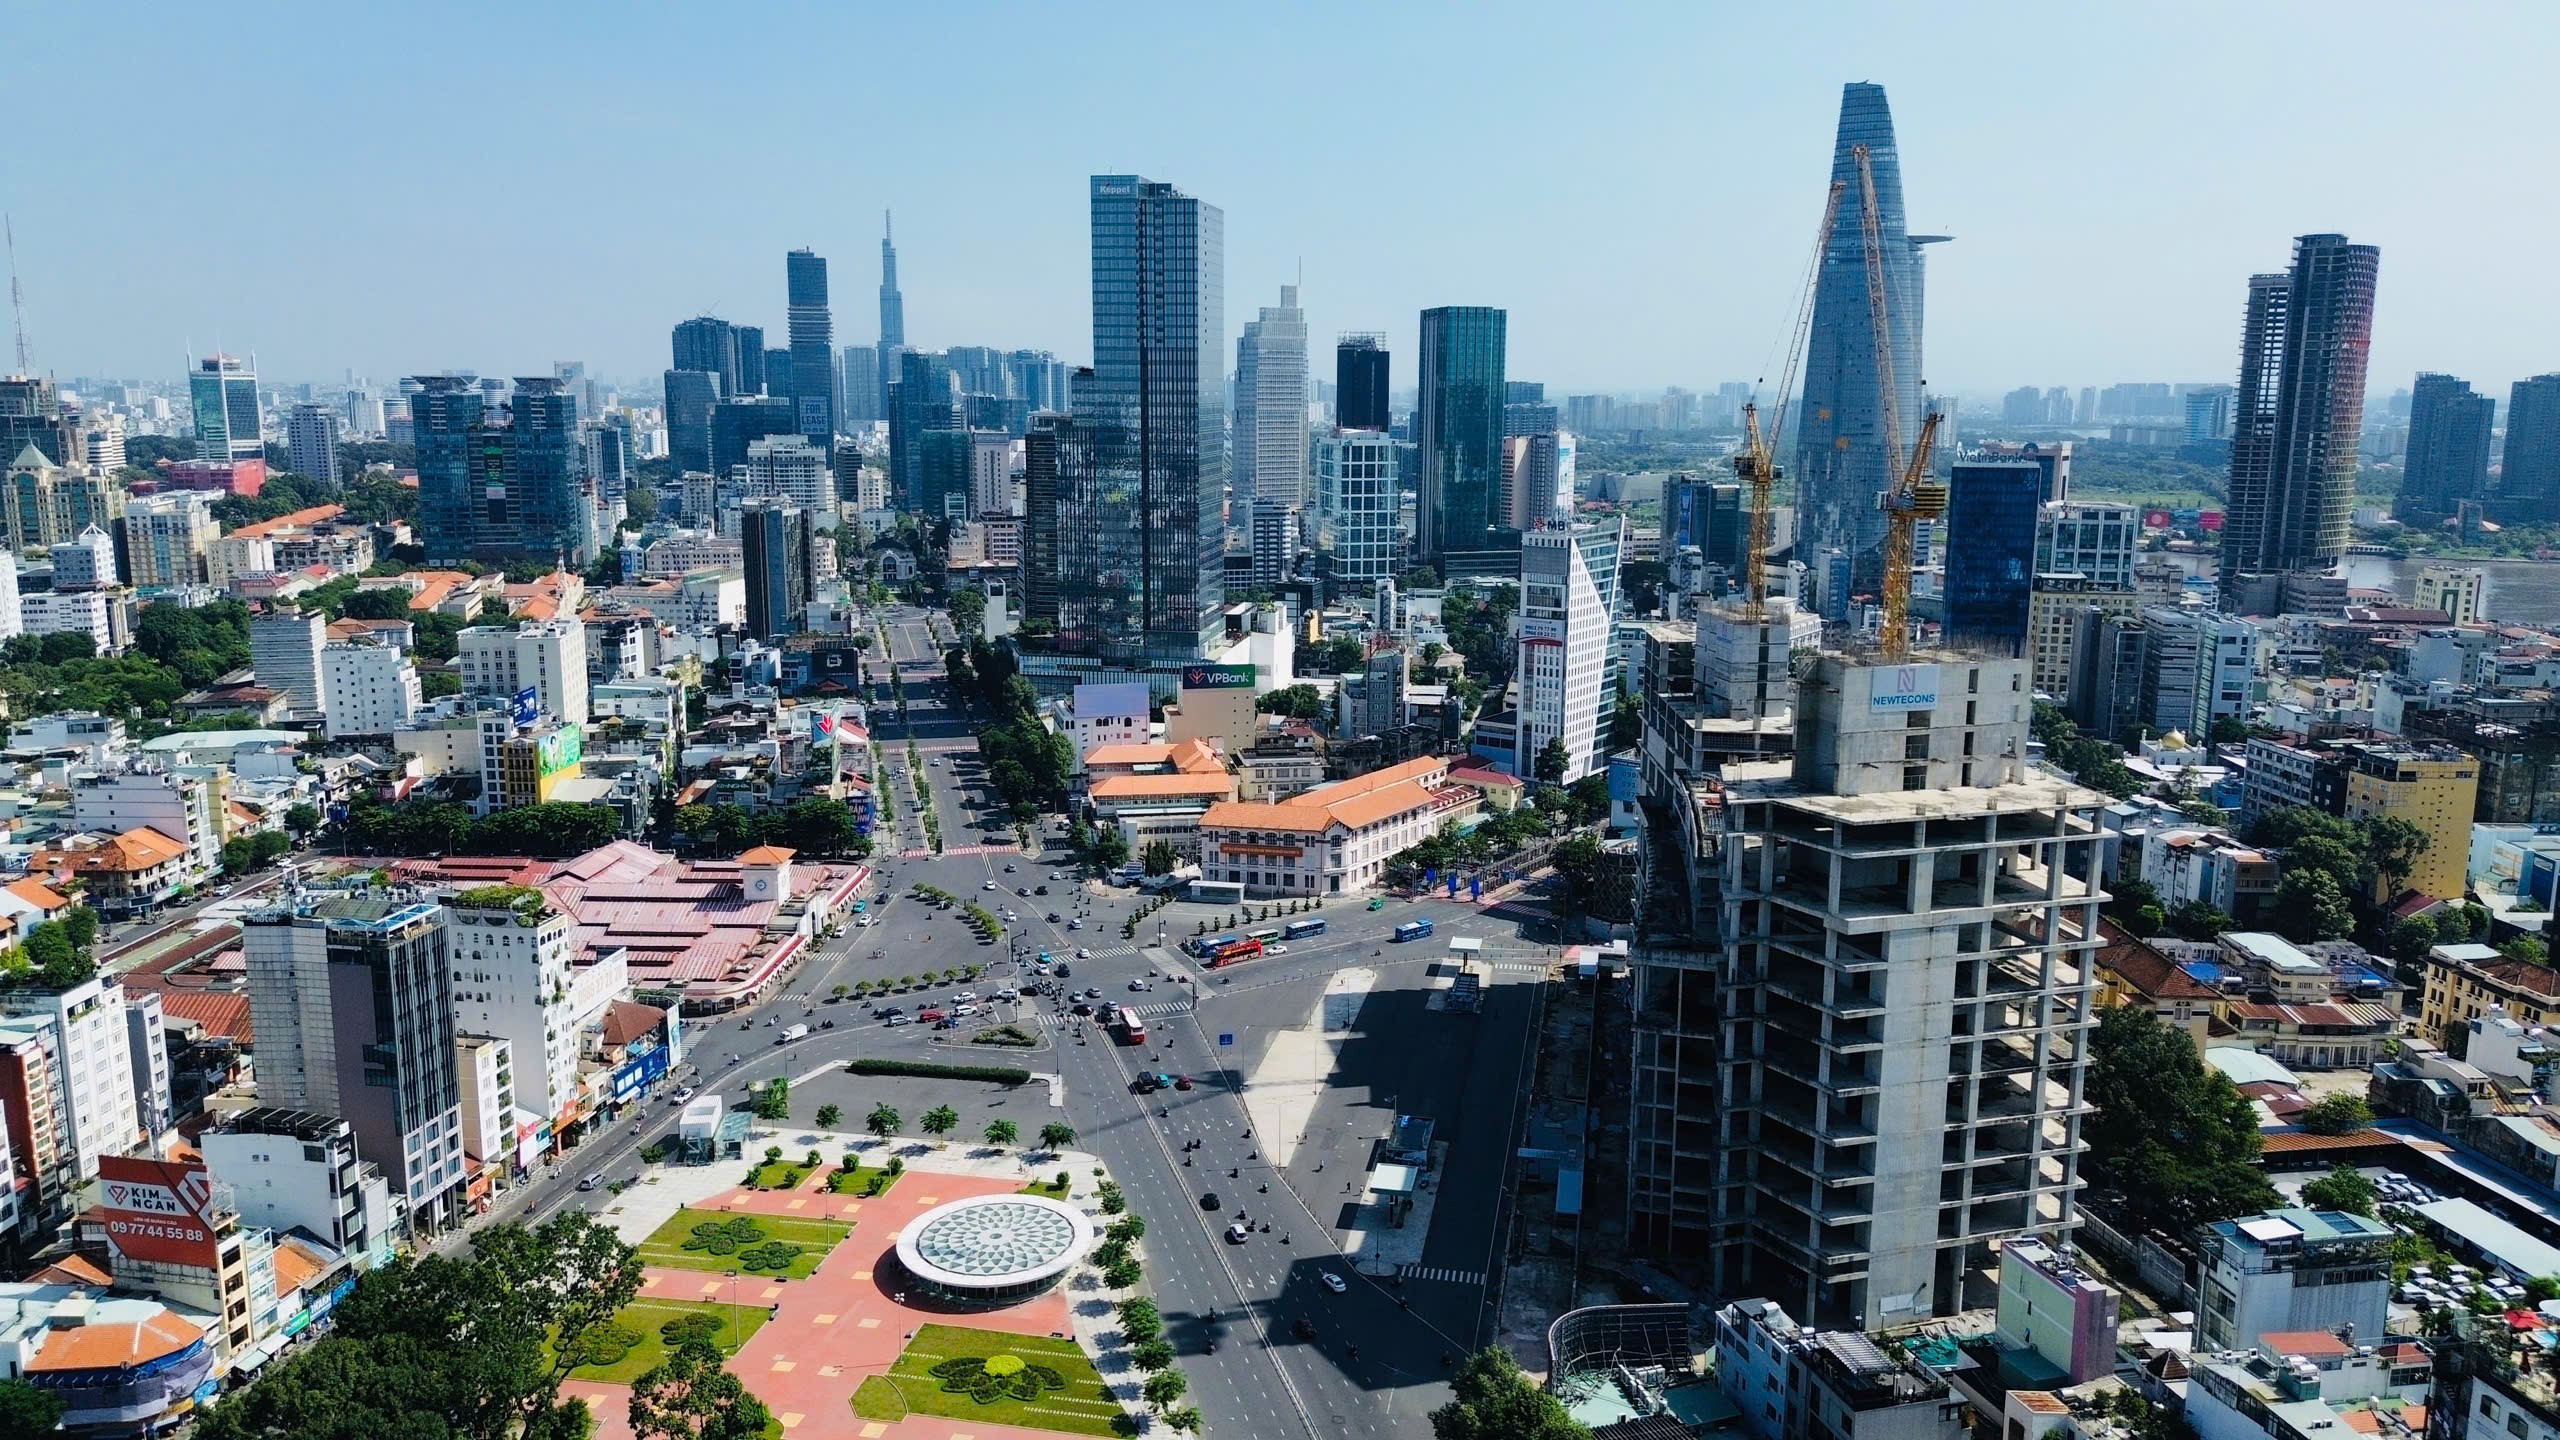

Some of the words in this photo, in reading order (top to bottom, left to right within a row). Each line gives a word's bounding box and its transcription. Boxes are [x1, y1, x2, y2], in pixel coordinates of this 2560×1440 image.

[1100, 185, 1130, 195] Keppel
[805, 403, 821, 414] FOR
[801, 415, 827, 425] LEASE
[1959, 449, 2024, 464] VietinBank
[1547, 520, 1565, 531] MB
[1207, 672, 1249, 684] VPBank
[1873, 694, 1935, 706] NEWTECONS
[253, 912, 278, 923] hotel
[131, 1187, 160, 1200] KIM
[132, 1199, 176, 1212] NGAN
[110, 1221, 127, 1233] 09
[128, 1223, 145, 1235] 77
[147, 1225, 164, 1238] 44
[166, 1227, 184, 1240] 55
[186, 1229, 204, 1242] 88
